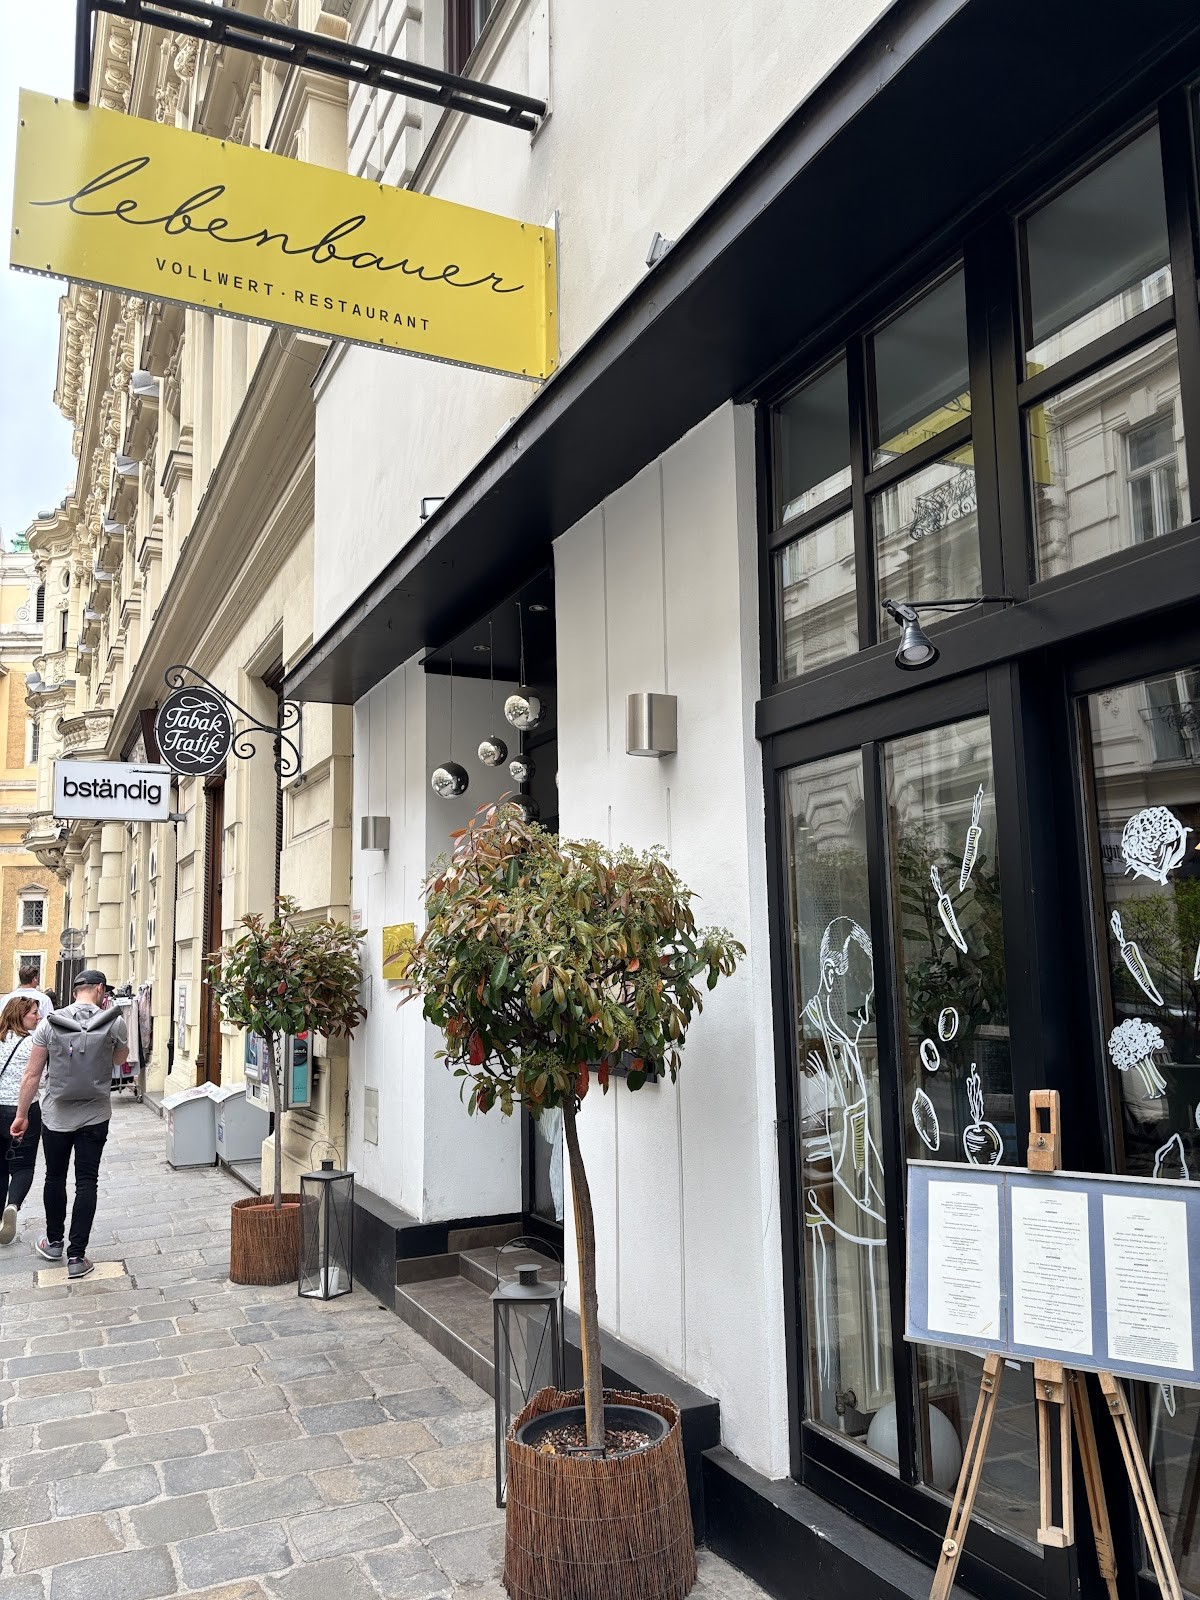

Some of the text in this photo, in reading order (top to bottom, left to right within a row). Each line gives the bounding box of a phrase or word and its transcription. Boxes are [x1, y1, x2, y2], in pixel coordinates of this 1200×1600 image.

[29, 156, 525, 293] lebenbauer
[165, 705, 227, 734] Tabak
[163, 730, 225, 757] Trafik
[63, 777, 162, 804] bständig
